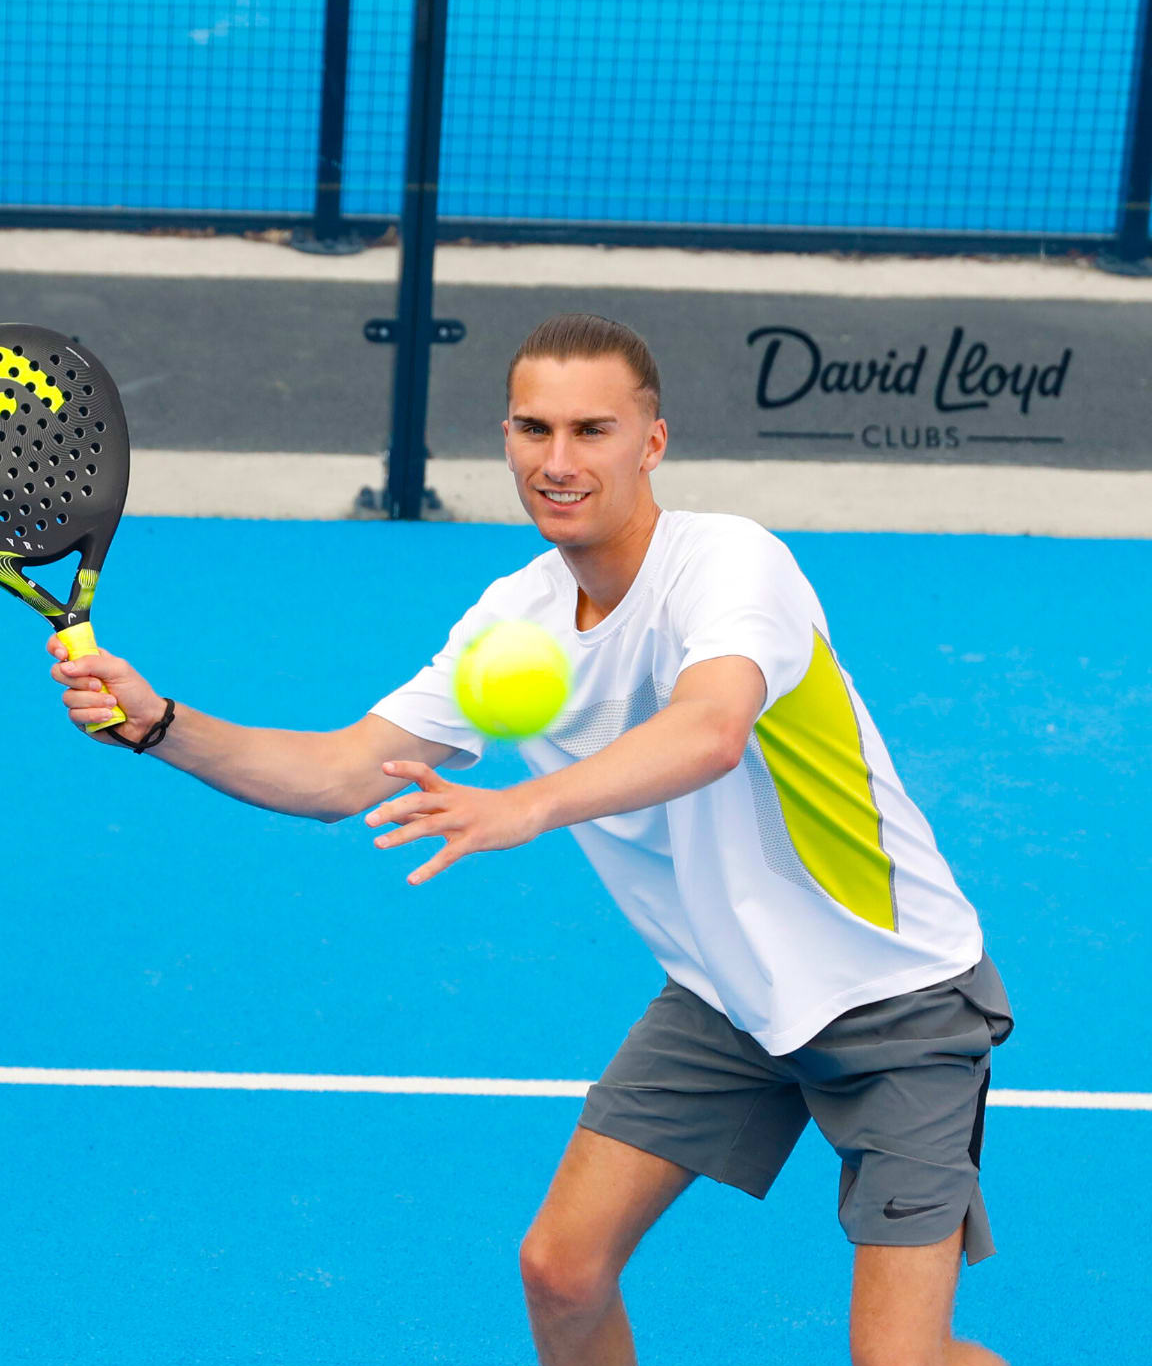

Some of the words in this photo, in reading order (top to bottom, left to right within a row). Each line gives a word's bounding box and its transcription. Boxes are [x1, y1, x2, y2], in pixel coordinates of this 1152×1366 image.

[746, 325, 928, 410] David
[934, 326, 1073, 415] Lloyd
[861, 424, 960, 450] CLUBS
